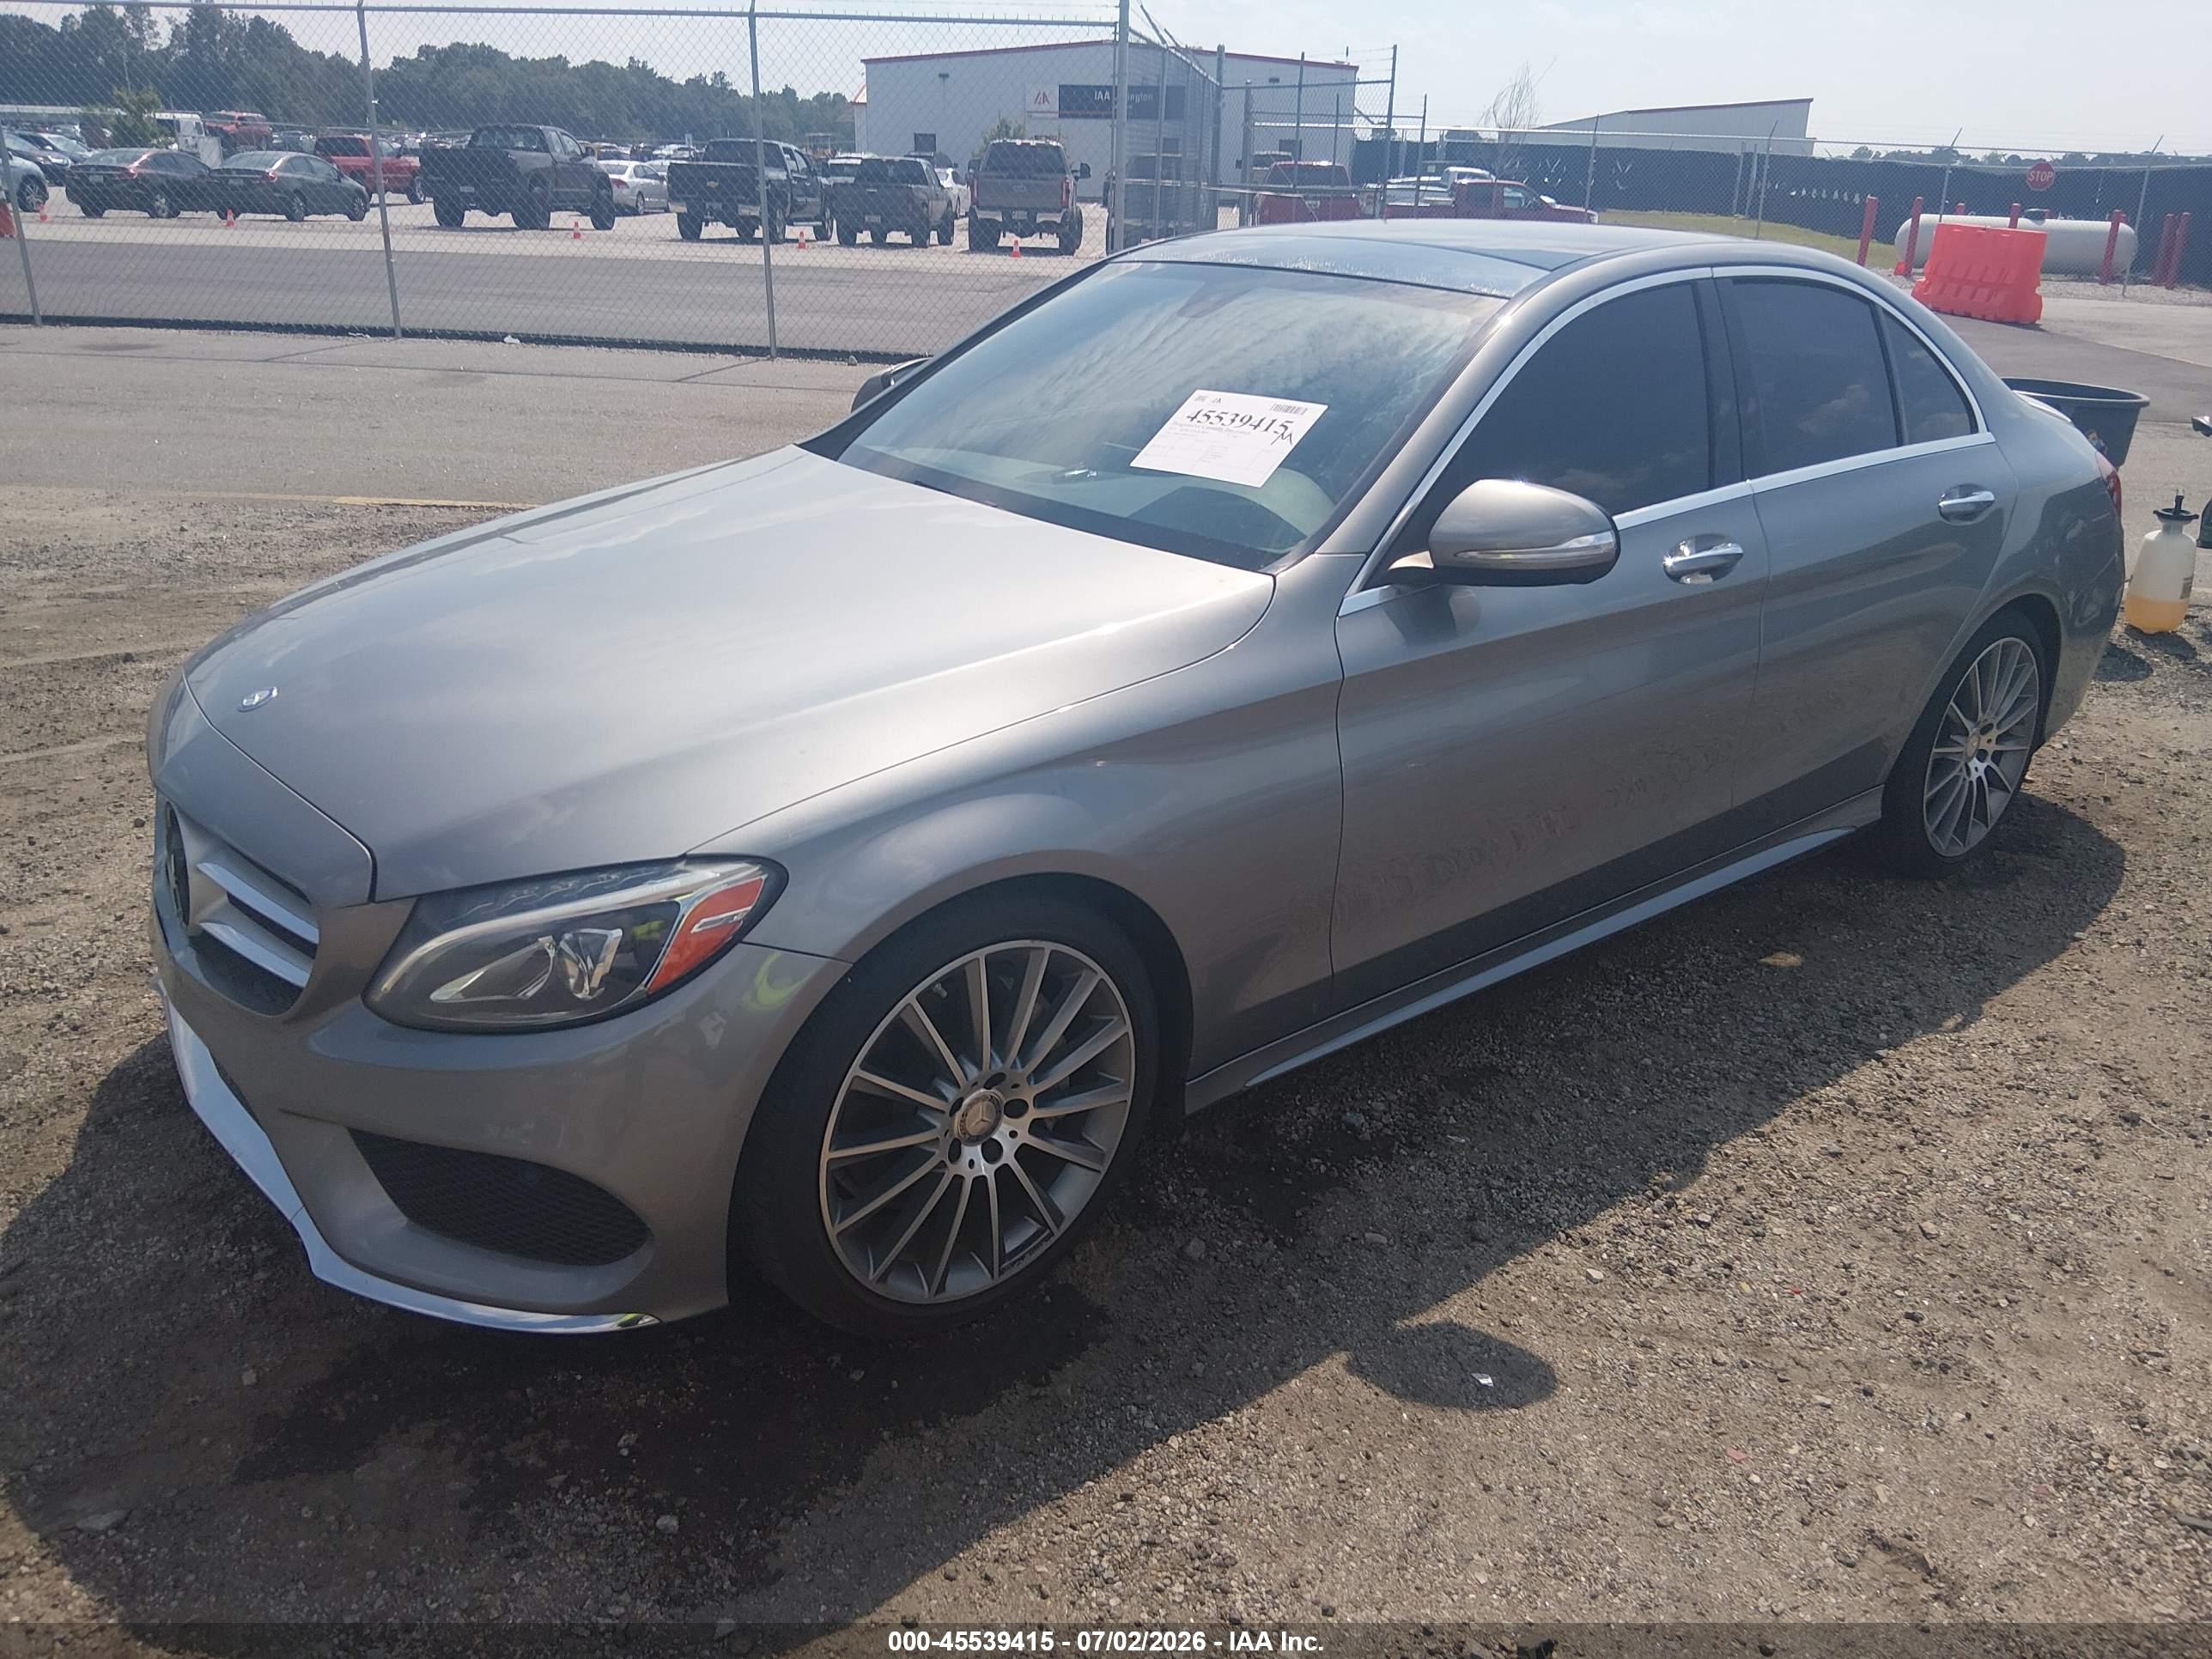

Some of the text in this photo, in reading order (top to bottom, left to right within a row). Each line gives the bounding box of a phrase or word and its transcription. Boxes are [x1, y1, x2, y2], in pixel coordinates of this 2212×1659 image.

[1094, 90, 1110, 101] IAA
[2028, 171, 2054, 182] STOP
[1187, 409, 1294, 434] 45539415
